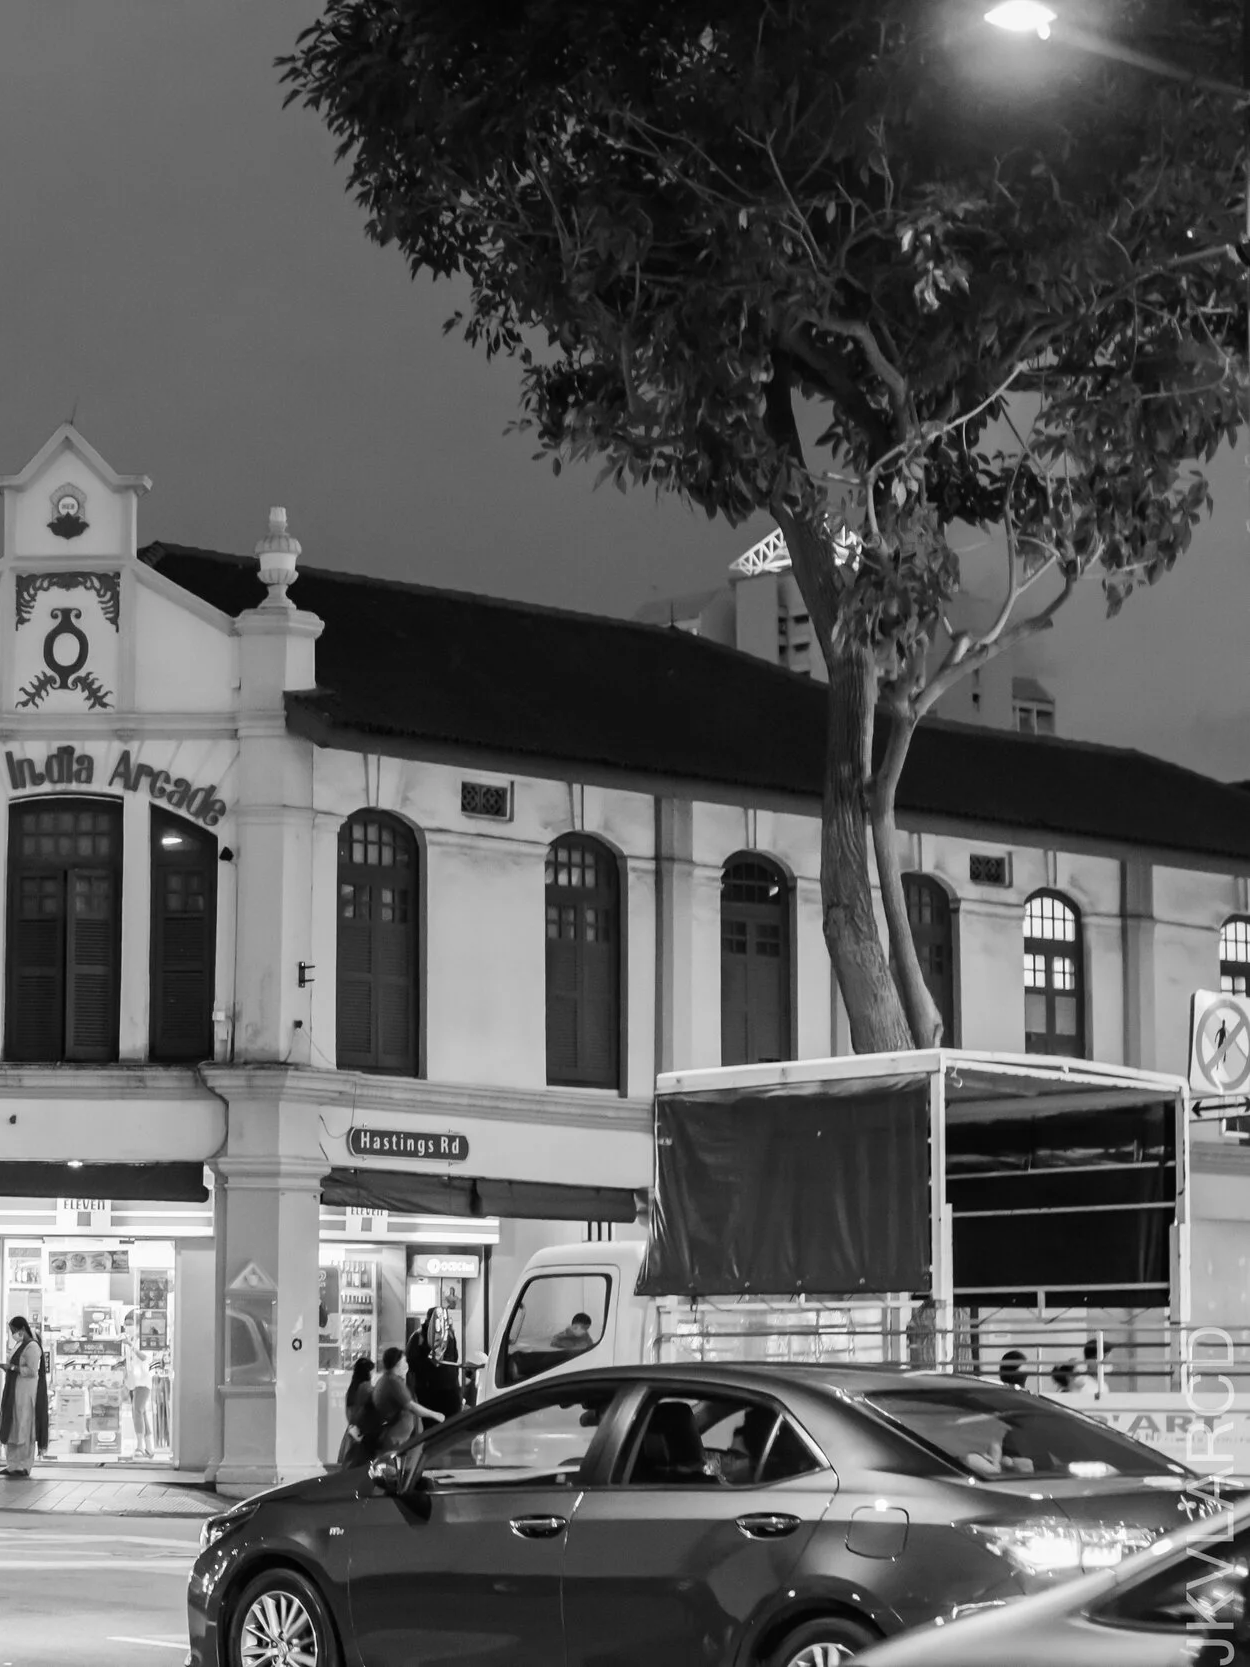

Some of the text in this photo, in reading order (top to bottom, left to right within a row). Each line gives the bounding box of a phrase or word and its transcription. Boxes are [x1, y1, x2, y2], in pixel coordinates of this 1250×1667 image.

[5, 745, 94, 790] India
[108, 749, 227, 827] Arcade
[360, 1131, 460, 1156] Hastings Rd
